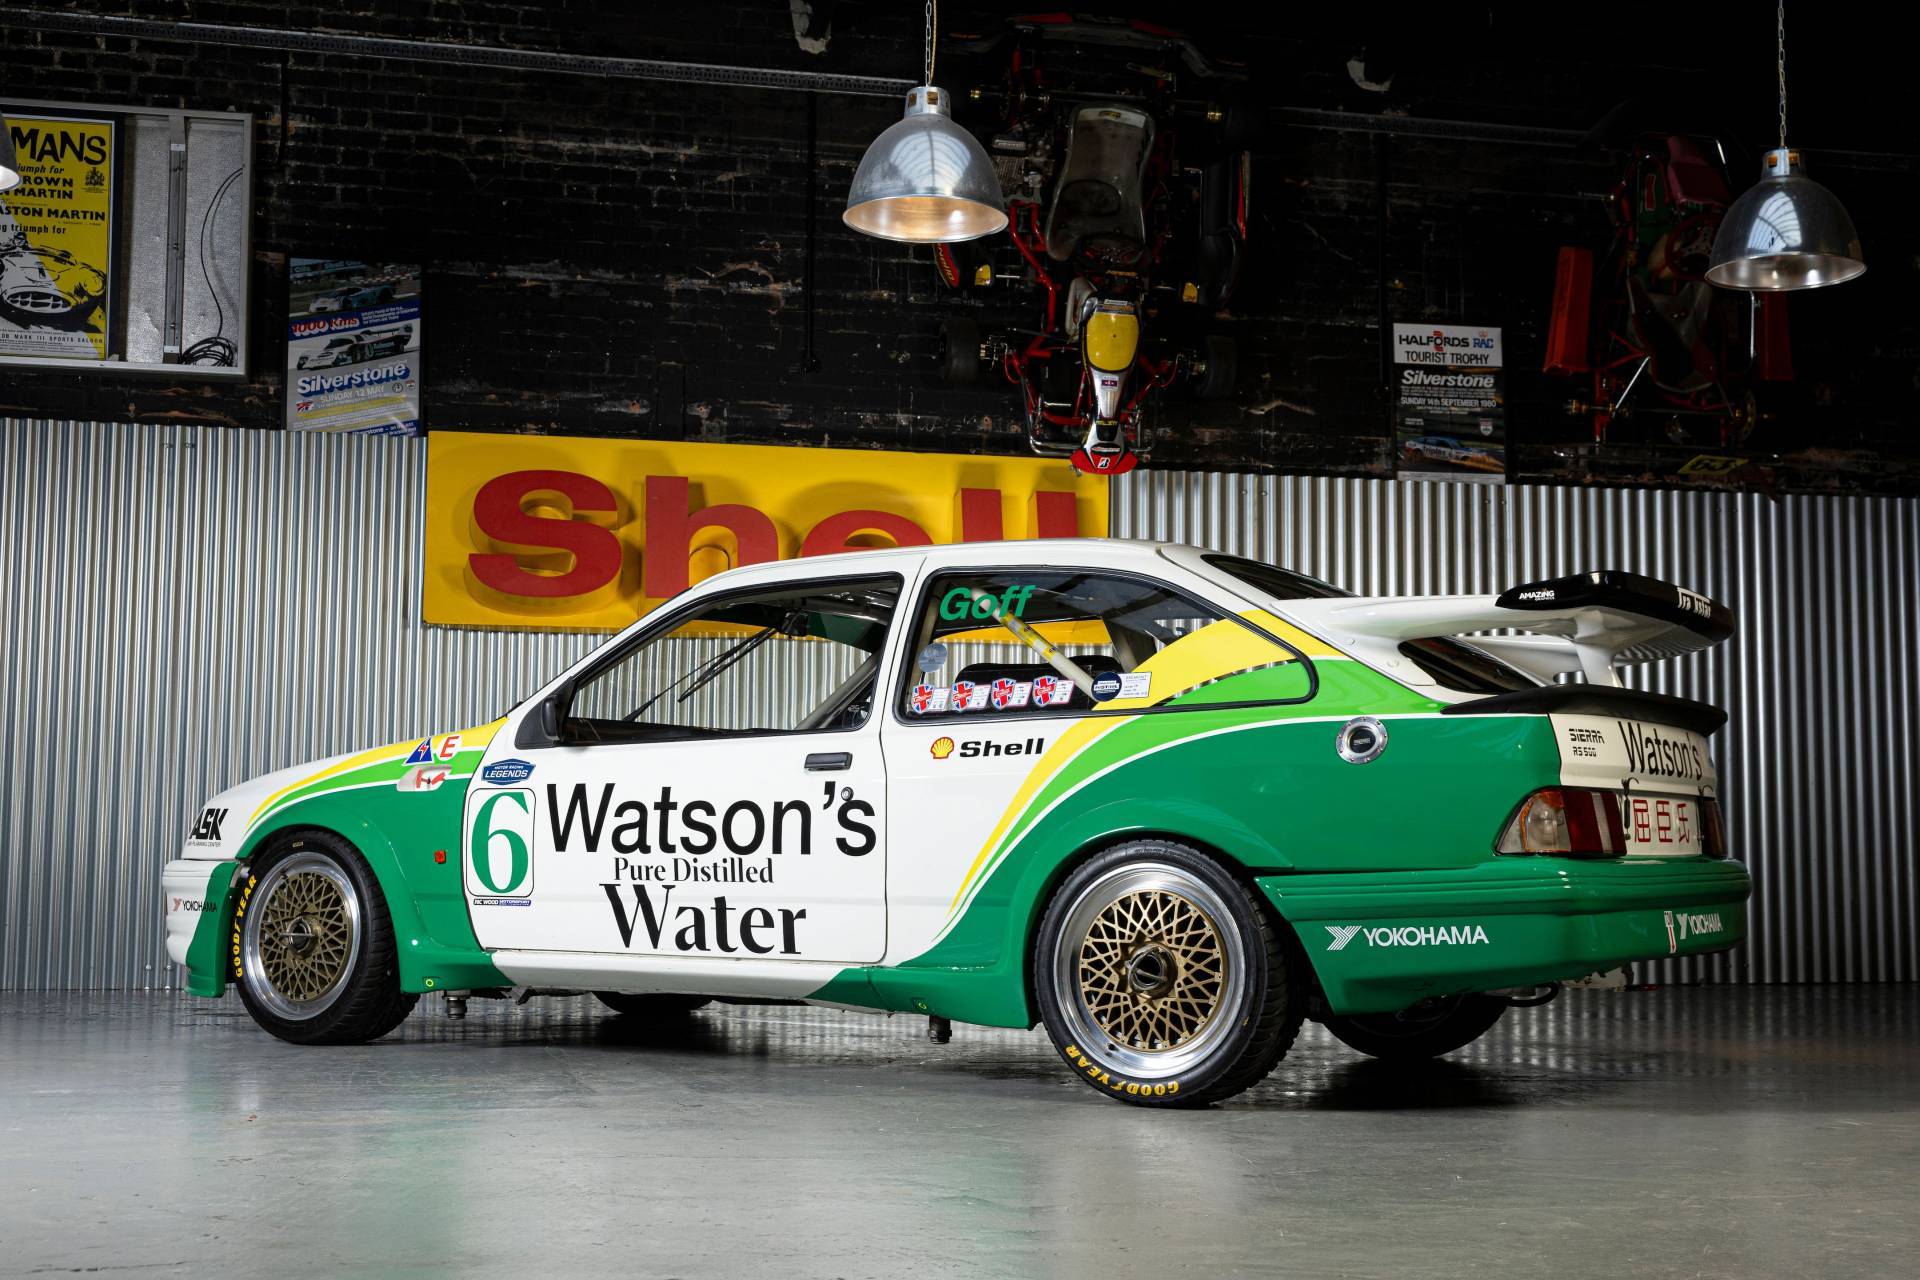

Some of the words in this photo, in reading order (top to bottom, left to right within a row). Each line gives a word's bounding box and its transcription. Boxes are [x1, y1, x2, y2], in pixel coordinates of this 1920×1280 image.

[11, 126, 107, 166] MANS
[17, 163, 46, 174] iumph
[50, 165, 65, 174] for
[22, 175, 74, 188] ROWN
[14, 187, 73, 199] MARTIN
[47, 208, 106, 221] MARTIN
[11, 223, 49, 235] triumph
[52, 225, 67, 235] for
[292, 320, 329, 337] 1000
[49, 335, 75, 343] SPORTS
[1398, 334, 1470, 348] HALFORDS
[1472, 337, 1495, 349] RAC
[1404, 350, 1448, 364] TOURIST
[1449, 352, 1490, 365] TROPHY
[297, 363, 408, 396] Silverstone
[1401, 369, 1495, 388] Silverstone
[320, 391, 353, 403] SUNDAY
[366, 385, 385, 396] MAY
[1401, 396, 1427, 405] SUNDAY
[1440, 397, 1479, 407] SEPTEMBER
[939, 584, 1036, 621] Goff
[1519, 590, 1555, 600] AMAZING
[1568, 728, 1605, 744] SIERRA
[440, 735, 460, 758] E
[959, 737, 1044, 758] Shell
[1572, 746, 1583, 757] RS
[1584, 746, 1597, 757] 500
[1618, 720, 1703, 781] Watson's
[485, 769, 529, 778] LEGENDS
[188, 808, 229, 841] ASK
[546, 781, 877, 857] Watson's
[1632, 799, 1690, 844] 屈臣氏
[471, 790, 530, 894] 6
[614, 857, 666, 882] Pure
[673, 857, 775, 884] Distilled
[183, 900, 218, 913] YOKOHAMA
[232, 874, 257, 979] GOODYEAR
[598, 883, 807, 956] Water
[1688, 913, 1724, 936] YOKOHAMA
[1362, 925, 1490, 947] YOKOHAMA
[1065, 1044, 1180, 1097] GOODYEAR
